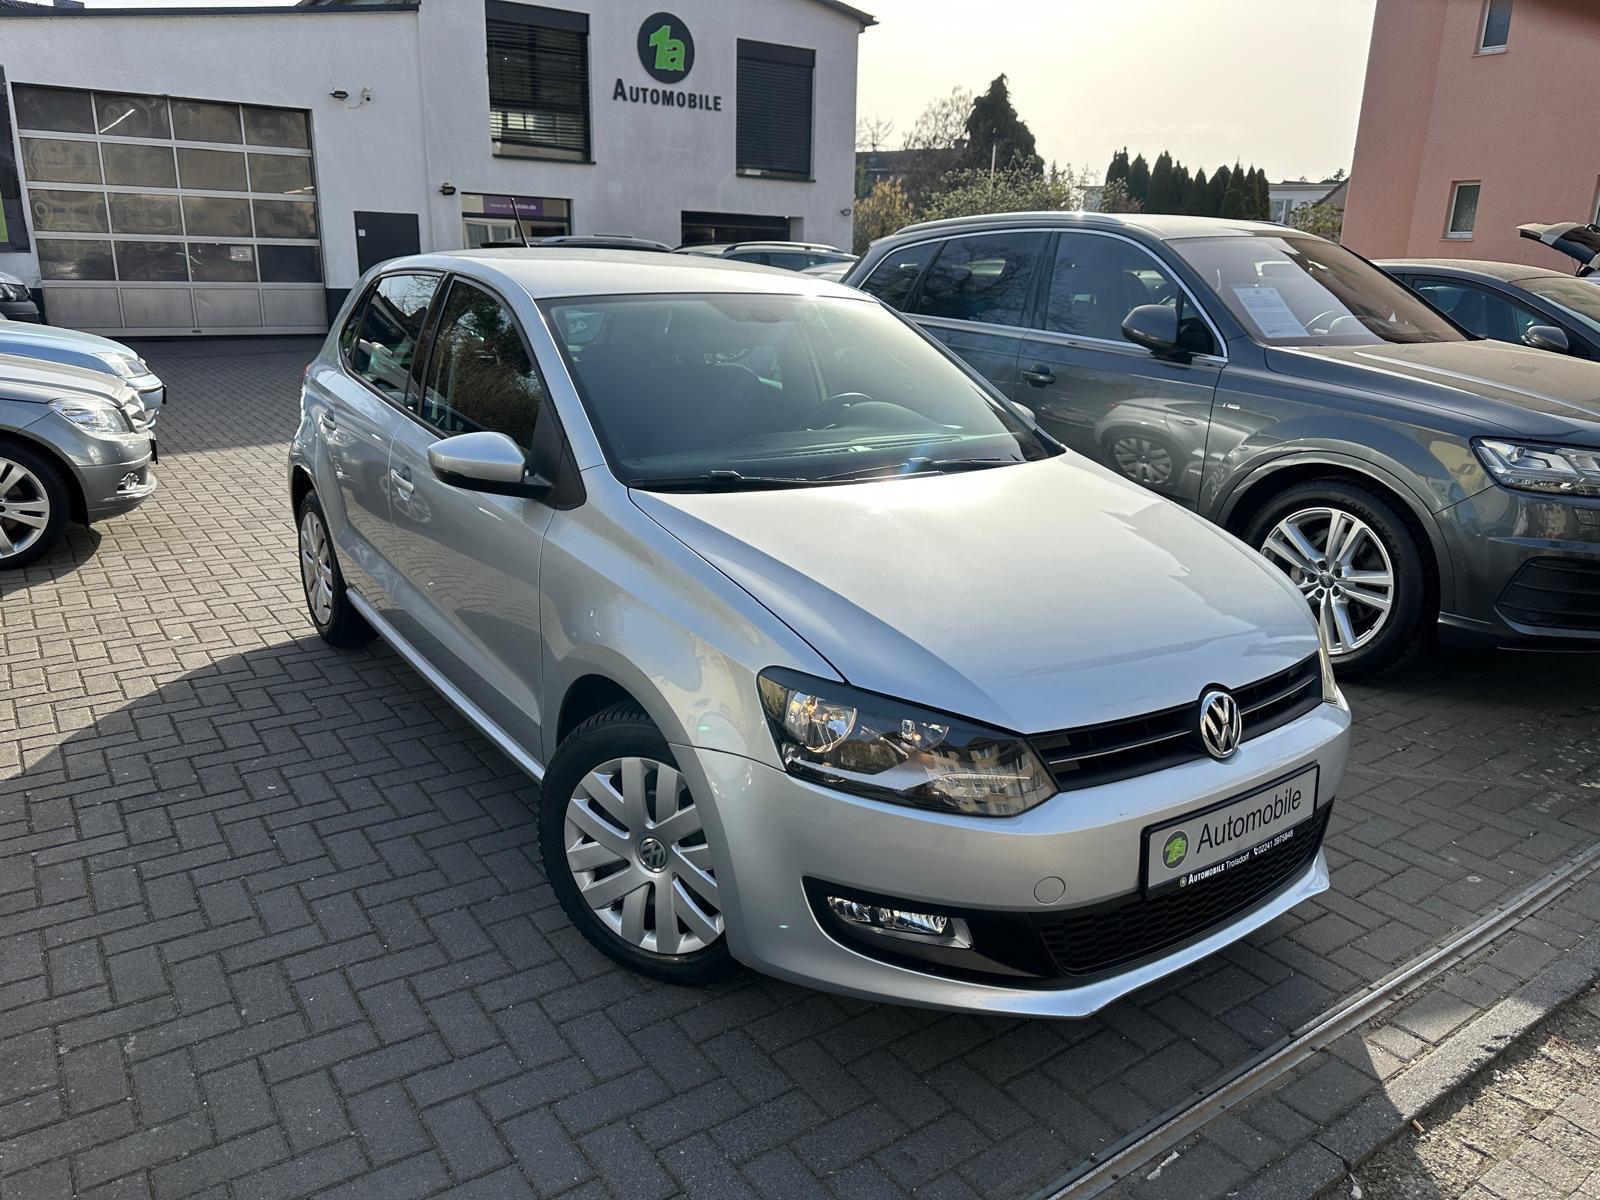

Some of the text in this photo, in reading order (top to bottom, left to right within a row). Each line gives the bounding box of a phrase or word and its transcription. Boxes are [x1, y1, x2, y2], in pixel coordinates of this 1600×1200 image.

[649, 25, 685, 71] 1a
[612, 78, 722, 111] AUTOMOBILE
[1165, 787, 1301, 863] 1a Automobile
[1188, 864, 1225, 885] AUTOMOBILE
[1225, 852, 1250, 869] Troisdorf
